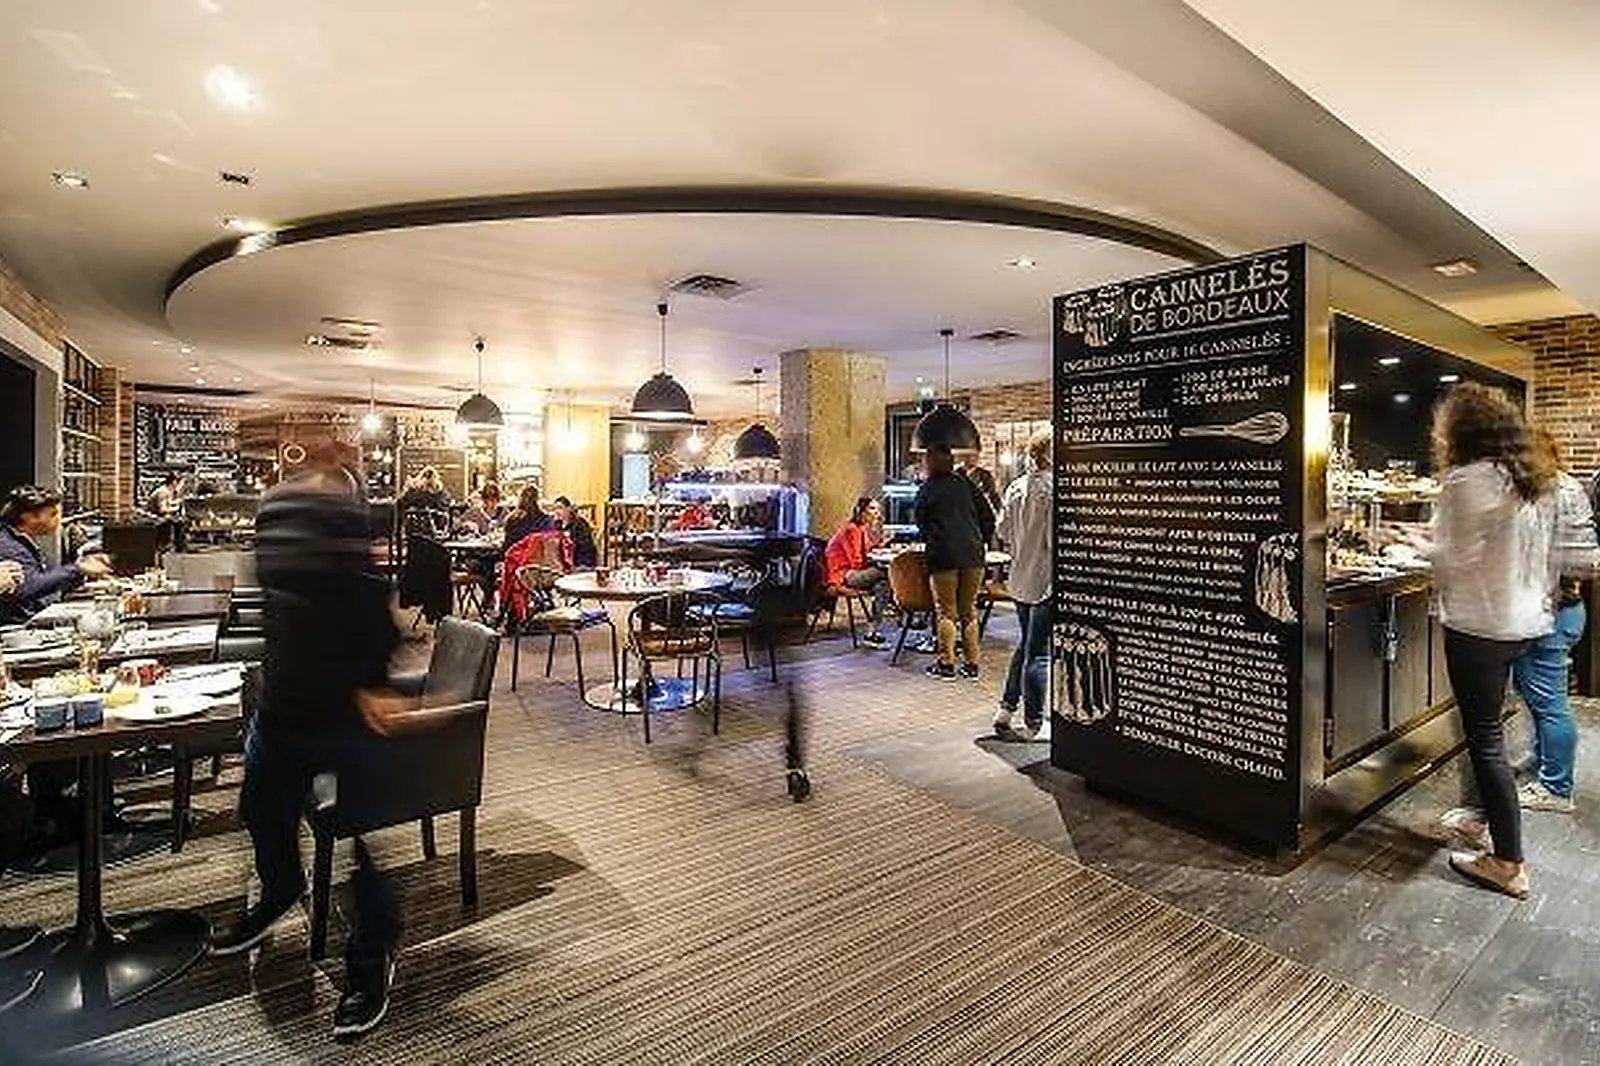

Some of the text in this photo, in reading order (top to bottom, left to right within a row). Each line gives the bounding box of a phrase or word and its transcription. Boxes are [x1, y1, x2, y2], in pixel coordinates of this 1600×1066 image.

[1131, 258, 1289, 311] CANNELÉS
[1130, 288, 1289, 334] DE BORDEAUX
